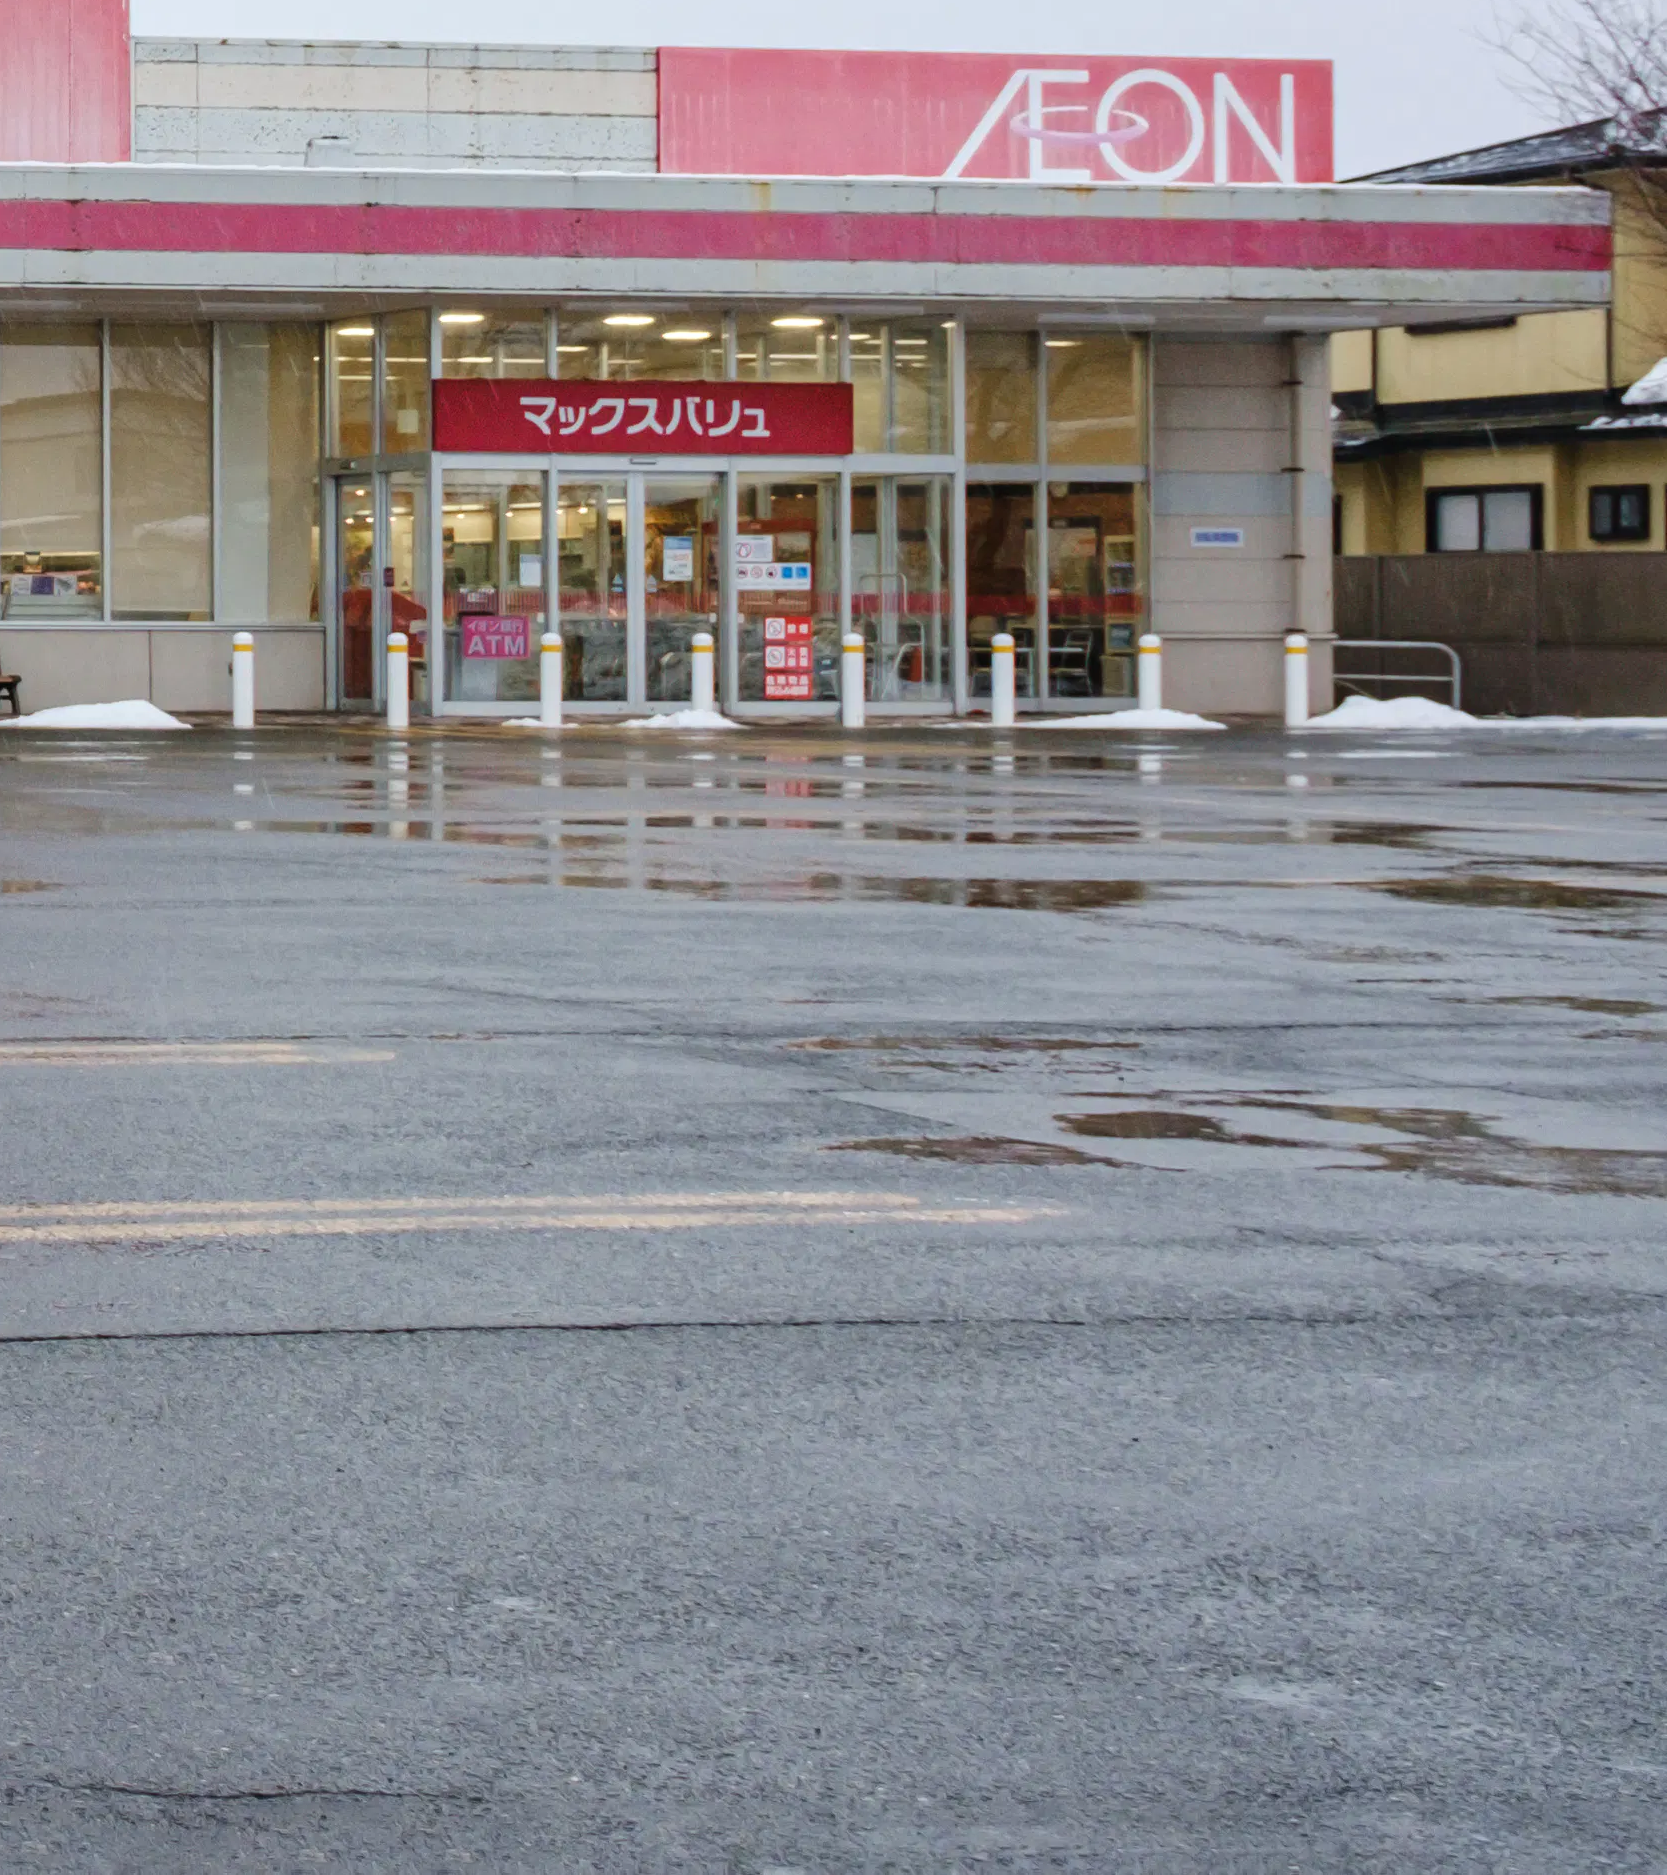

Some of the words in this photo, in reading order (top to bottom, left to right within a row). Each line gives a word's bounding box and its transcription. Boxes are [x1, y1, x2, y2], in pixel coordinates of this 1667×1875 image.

[519, 396, 771, 438] マックスバリュ
[468, 635, 525, 655] ATM
